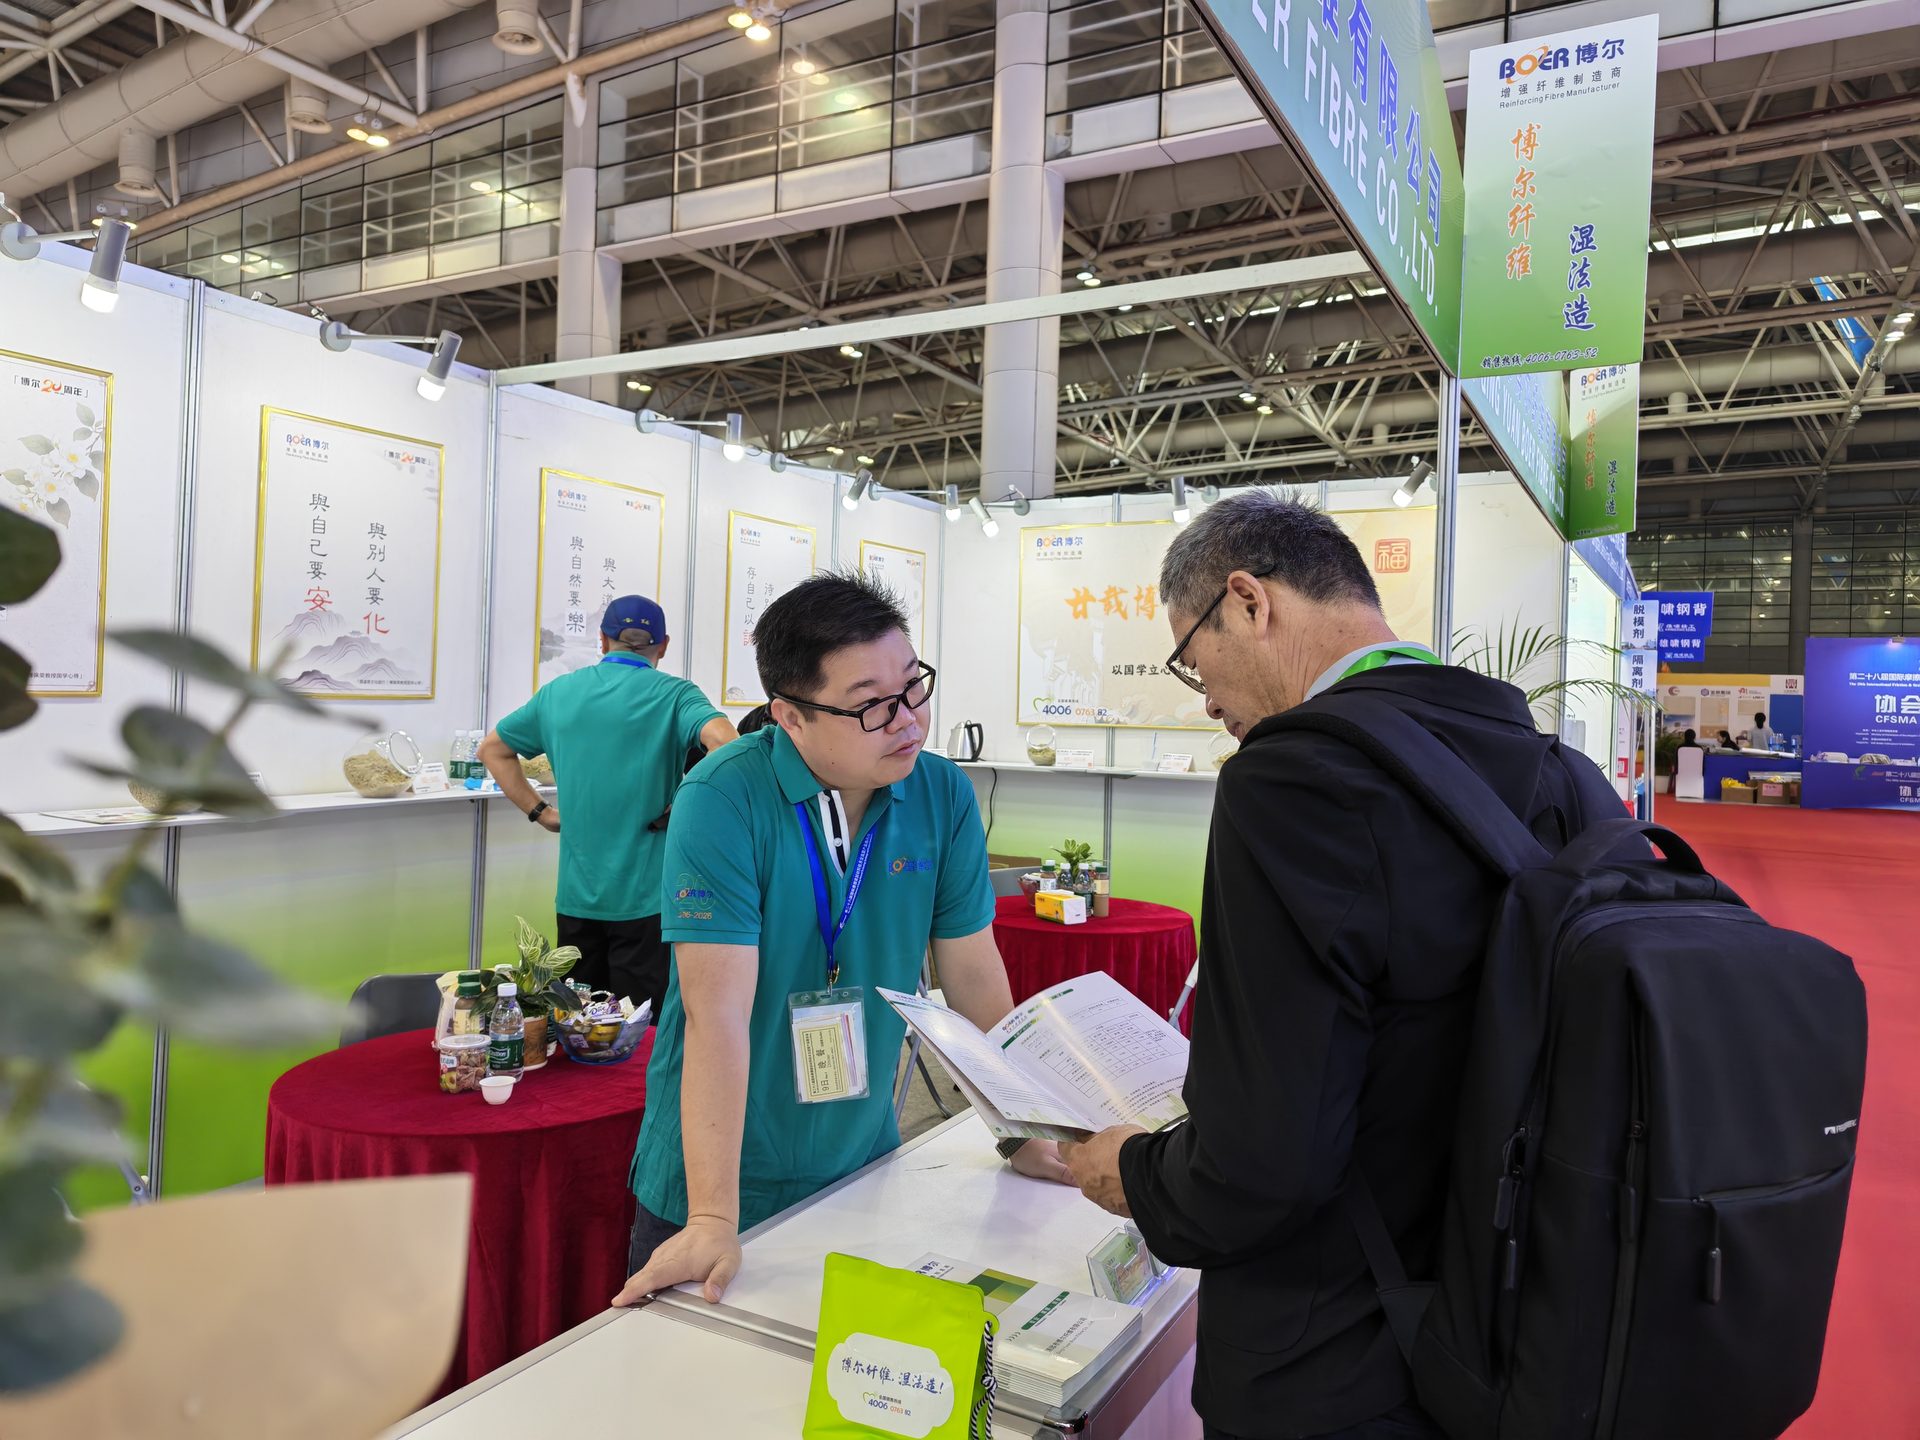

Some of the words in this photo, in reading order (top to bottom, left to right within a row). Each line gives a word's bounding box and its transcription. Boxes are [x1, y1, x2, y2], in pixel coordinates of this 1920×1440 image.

[1499, 43, 1569, 84] BOER
[1575, 39, 1625, 65] 博尔
[1499, 95, 1543, 109] Reinforcing
[1545, 91, 1565, 101] Fibre
[1566, 82, 1620, 97] Manufacturer
[1500, 66, 1622, 98] 增强纤维制造商
[1305, 17, 1368, 199] FIBRE
[1506, 123, 1542, 279] 博尔纤维
[1564, 224, 1598, 330] 湿法造
[304, 493, 334, 612] 與自己要安
[1632, 604, 1645, 639] 脱模剂
[1631, 654, 1644, 688] 隔离剂
[1042, 705, 1072, 715] 4006
[1075, 707, 1095, 716] 0763
[1097, 708, 1107, 716] 82
[1874, 694, 1920, 714] 协会
[1875, 715, 1917, 724] CFSMA
[868, 1398, 888, 1410] 4006
